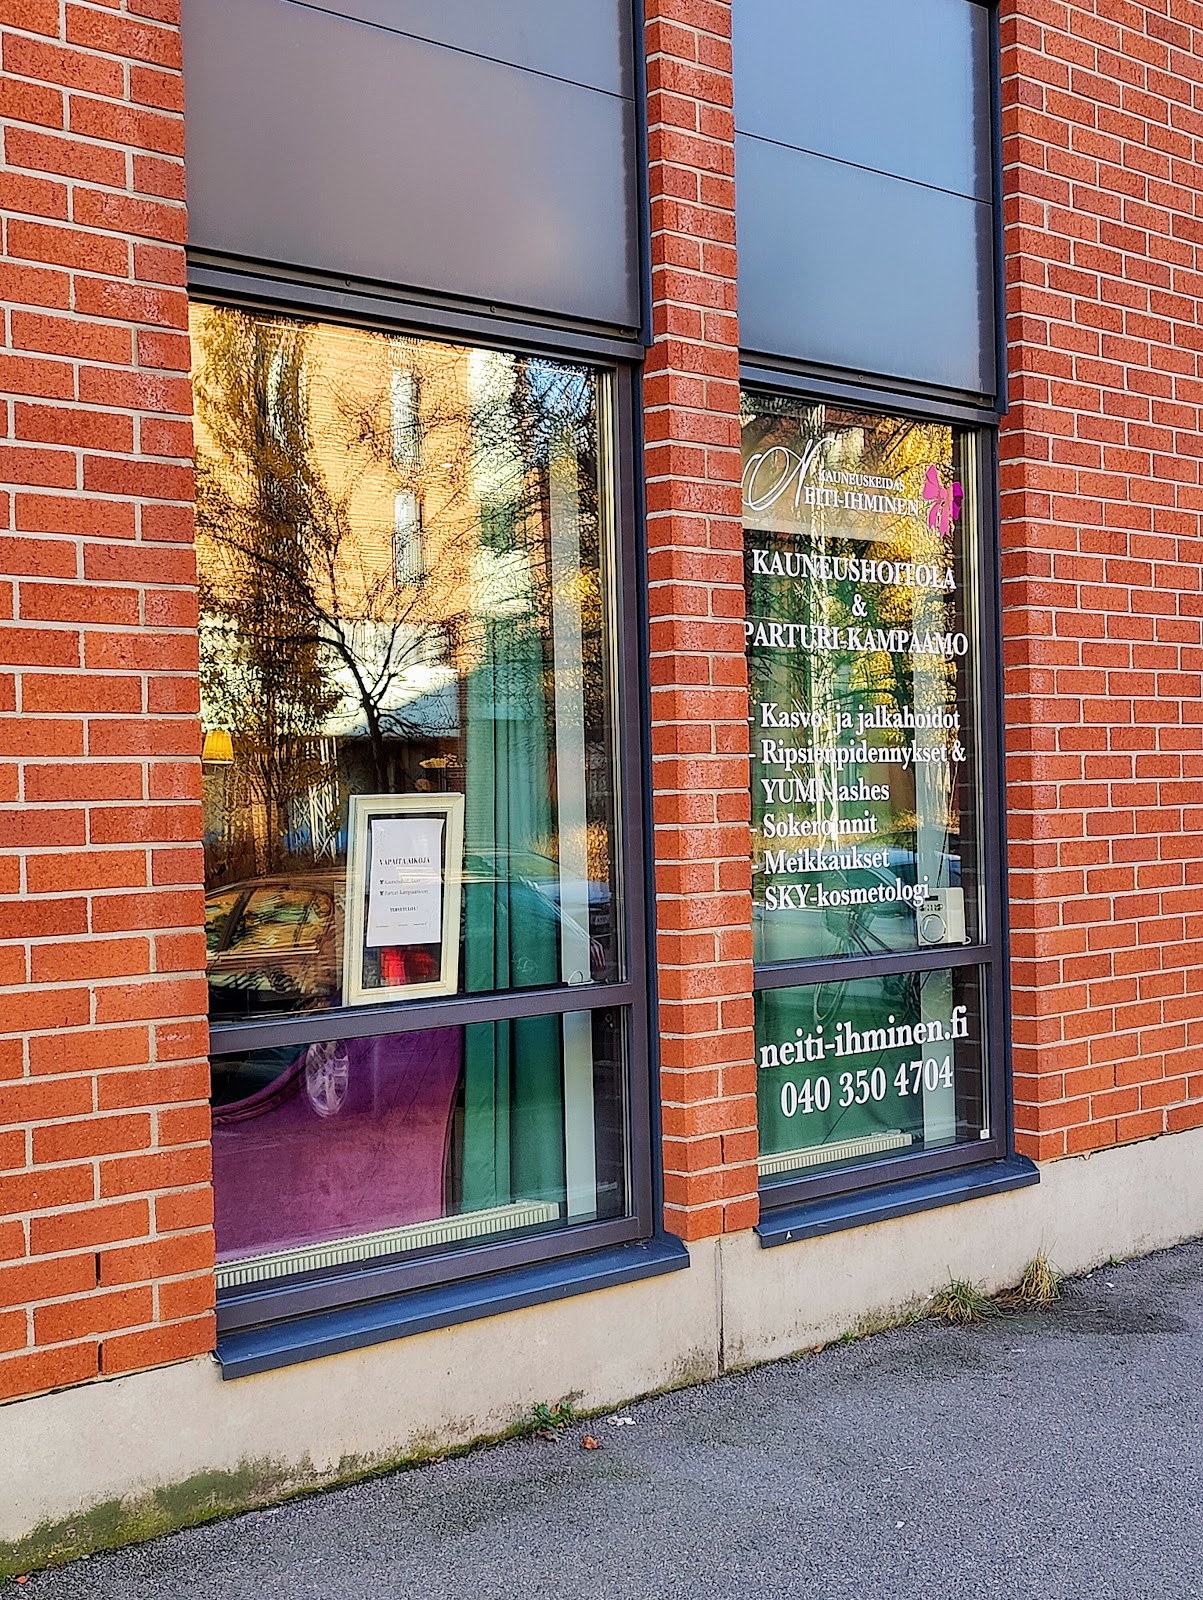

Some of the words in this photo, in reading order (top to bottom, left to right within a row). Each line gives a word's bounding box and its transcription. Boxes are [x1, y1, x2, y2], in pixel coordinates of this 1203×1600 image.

[819, 471, 905, 491] KAUNEUSKEIDAS
[751, 549, 957, 590] KAUNEUSHOITOLA
[852, 594, 868, 618] &
[743, 621, 969, 656] PARTURI-KAMPAAMO
[760, 702, 831, 729] Kasvo-
[835, 704, 853, 735] ja
[856, 704, 961, 736] jalkahoidot
[761, 739, 949, 772] Ripsienpidennykset
[951, 740, 967, 762] &
[763, 810, 878, 839] Sokeroinnit
[763, 846, 890, 875] Meikkaukset
[764, 876, 930, 911] SKY-kosmetologi
[760, 1005, 969, 1069] neiti-ihminen.fi
[780, 1076, 831, 1118] 040
[839, 1067, 887, 1108] 350
[894, 1055, 954, 1096] 4704
